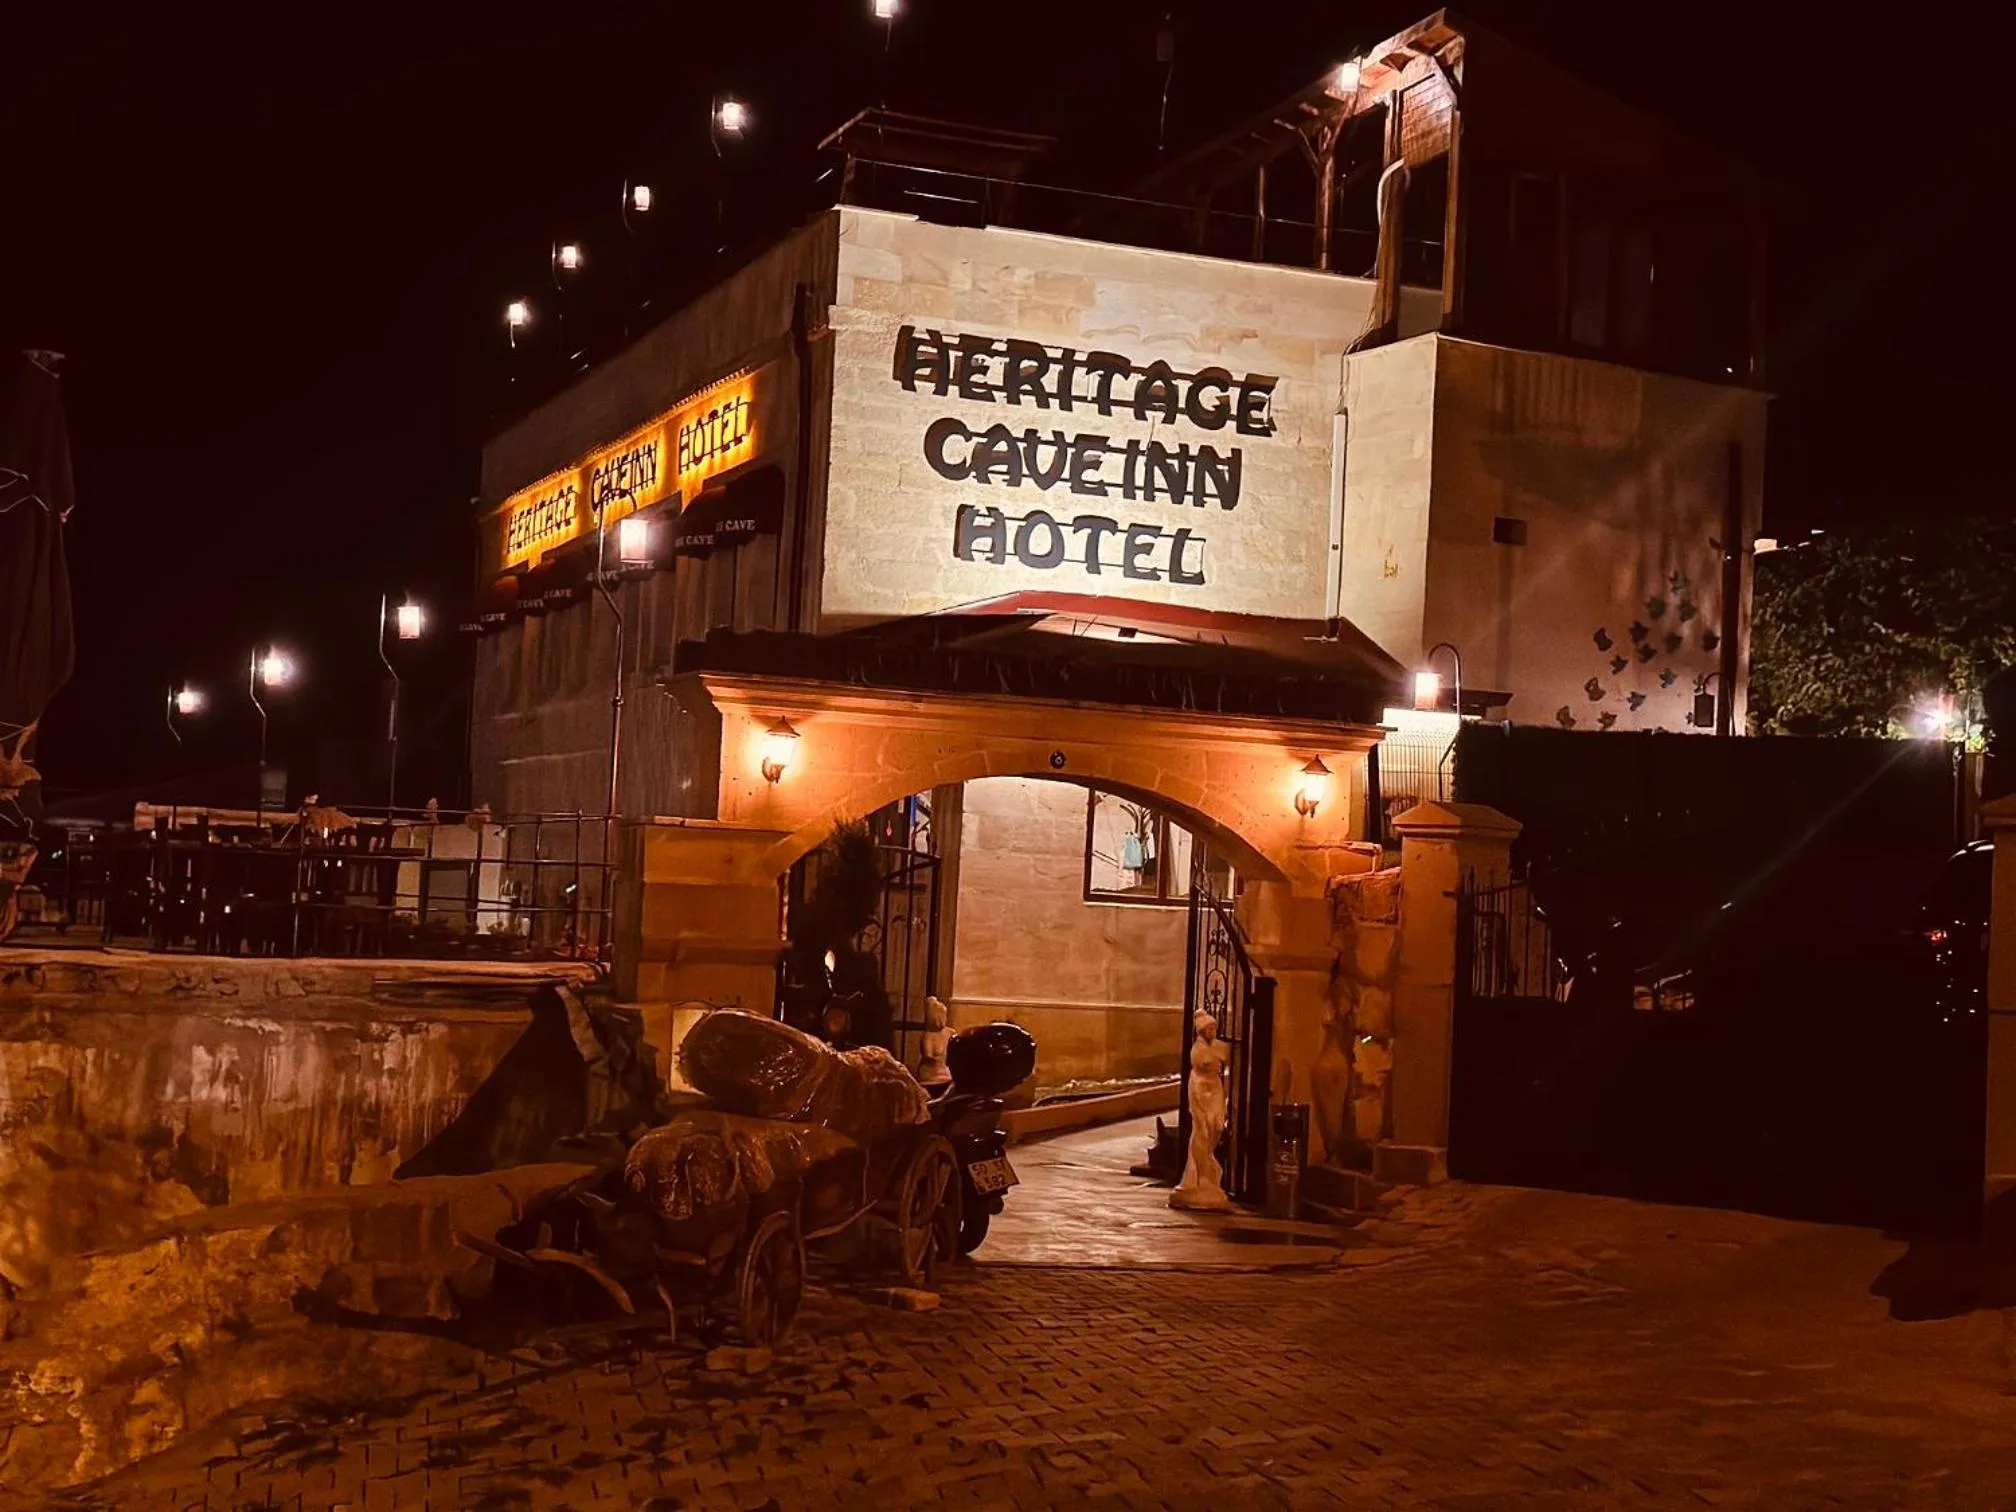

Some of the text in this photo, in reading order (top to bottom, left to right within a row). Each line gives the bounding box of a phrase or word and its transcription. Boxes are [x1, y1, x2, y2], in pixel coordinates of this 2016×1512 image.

[893, 325, 1279, 437] HERITAGE
[507, 485, 575, 553] HERITAGE
[679, 396, 747, 475] HOTEL
[686, 534, 715, 546] CAVE
[725, 519, 756, 531] CAVE
[952, 503, 1206, 585] HOTEL
